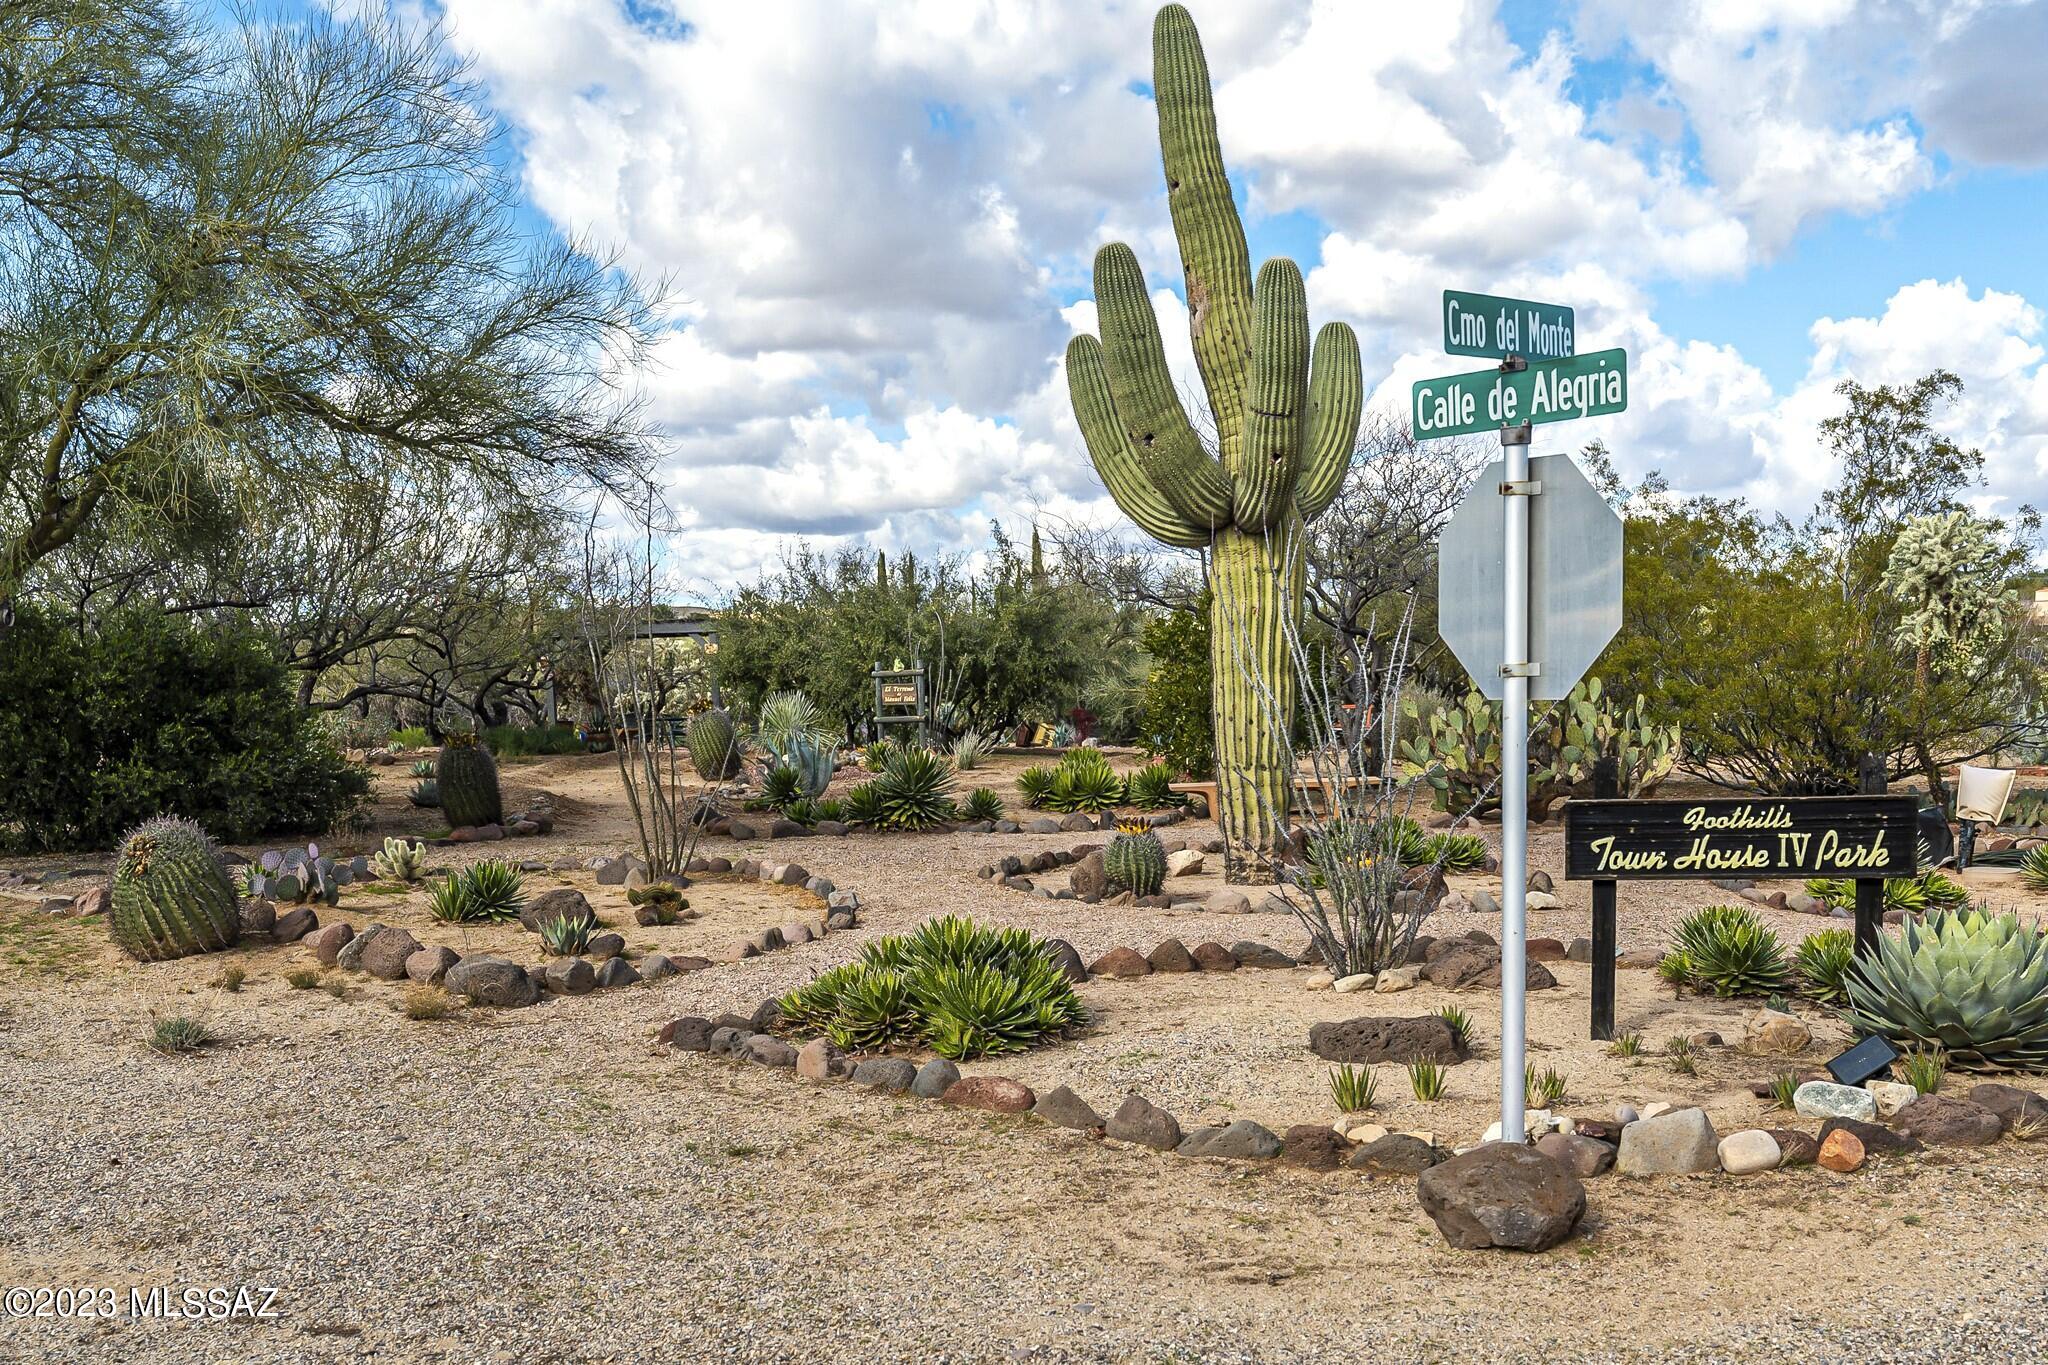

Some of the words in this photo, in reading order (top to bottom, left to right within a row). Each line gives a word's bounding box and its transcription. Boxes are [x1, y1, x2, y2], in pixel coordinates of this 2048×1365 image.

[1448, 300, 1486, 348] Cmo
[1496, 307, 1520, 351] del
[1528, 310, 1572, 357] Monte
[1417, 384, 1475, 430] Calle
[1488, 377, 1517, 421] de
[1531, 360, 1622, 417] Alegria
[1590, 836, 1667, 870] Town
[1673, 834, 1770, 870] House
[1778, 833, 1811, 867] IV
[1815, 829, 1890, 870] Park
